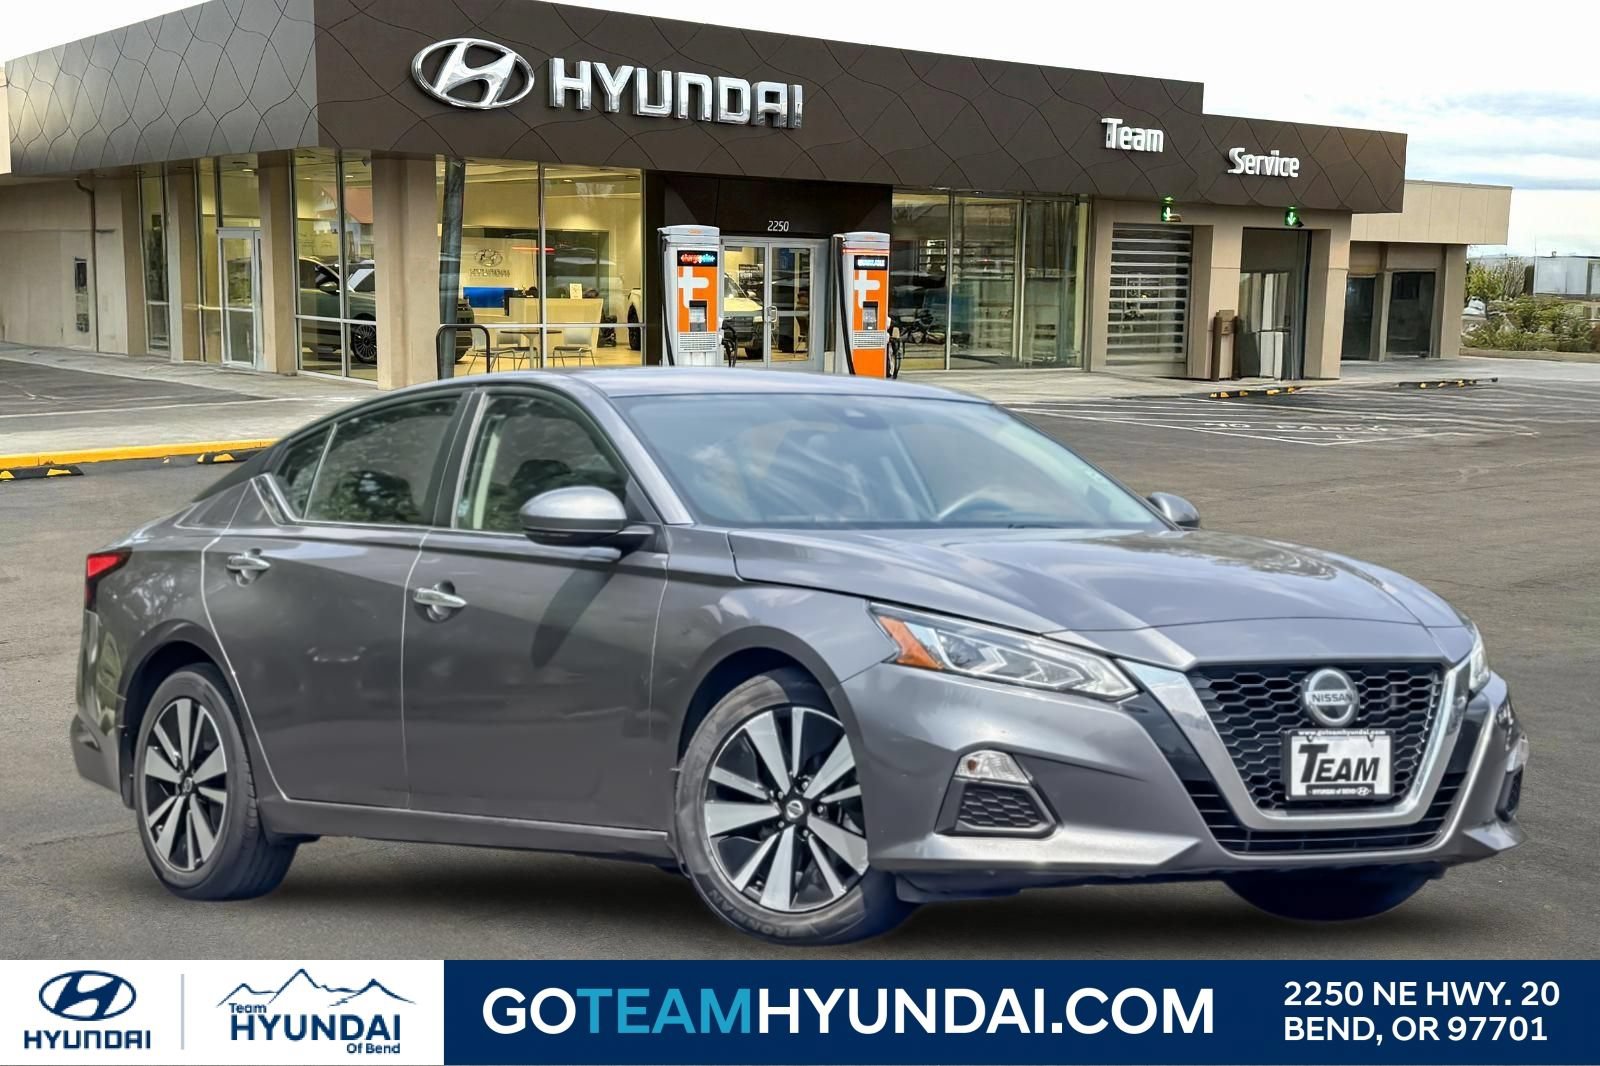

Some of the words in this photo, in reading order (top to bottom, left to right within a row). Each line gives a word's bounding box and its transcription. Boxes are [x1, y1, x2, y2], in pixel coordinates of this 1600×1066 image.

[549, 57, 804, 128] HYUNDAI
[1101, 118, 1164, 153] Team
[1227, 147, 1300, 178] Service
[767, 220, 790, 232] 2250
[1311, 692, 1354, 704] NISSAN
